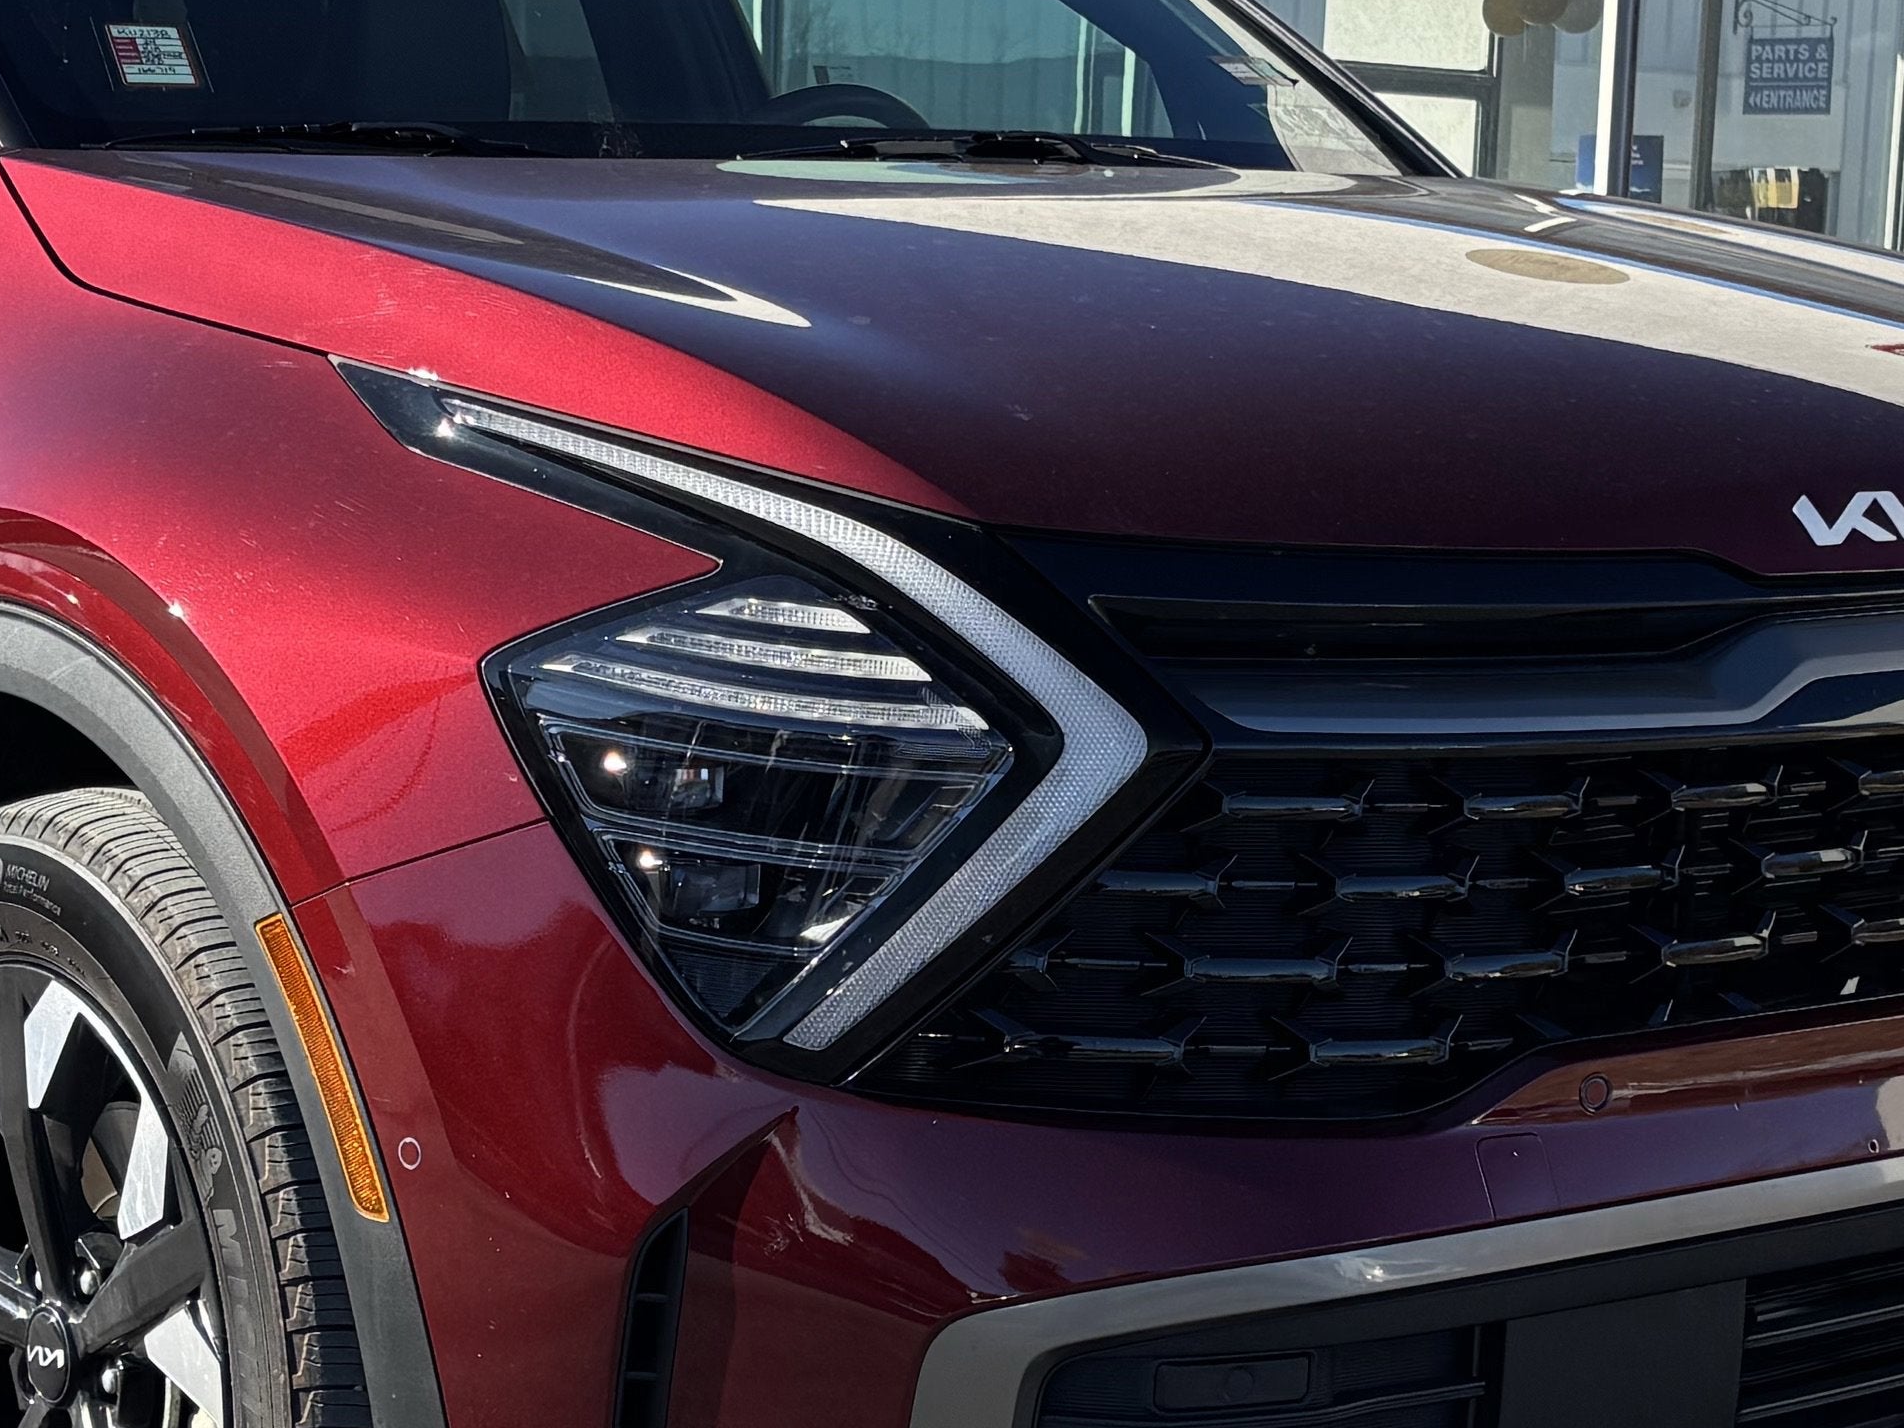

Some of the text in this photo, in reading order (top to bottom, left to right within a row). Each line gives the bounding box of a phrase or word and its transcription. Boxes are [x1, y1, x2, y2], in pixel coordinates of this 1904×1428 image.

[1751, 43, 1828, 60] PARTS &
[1749, 62, 1829, 79] SERVICE
[1762, 90, 1827, 109] ENTRANCE
[27, 1344, 65, 1369] KIA
